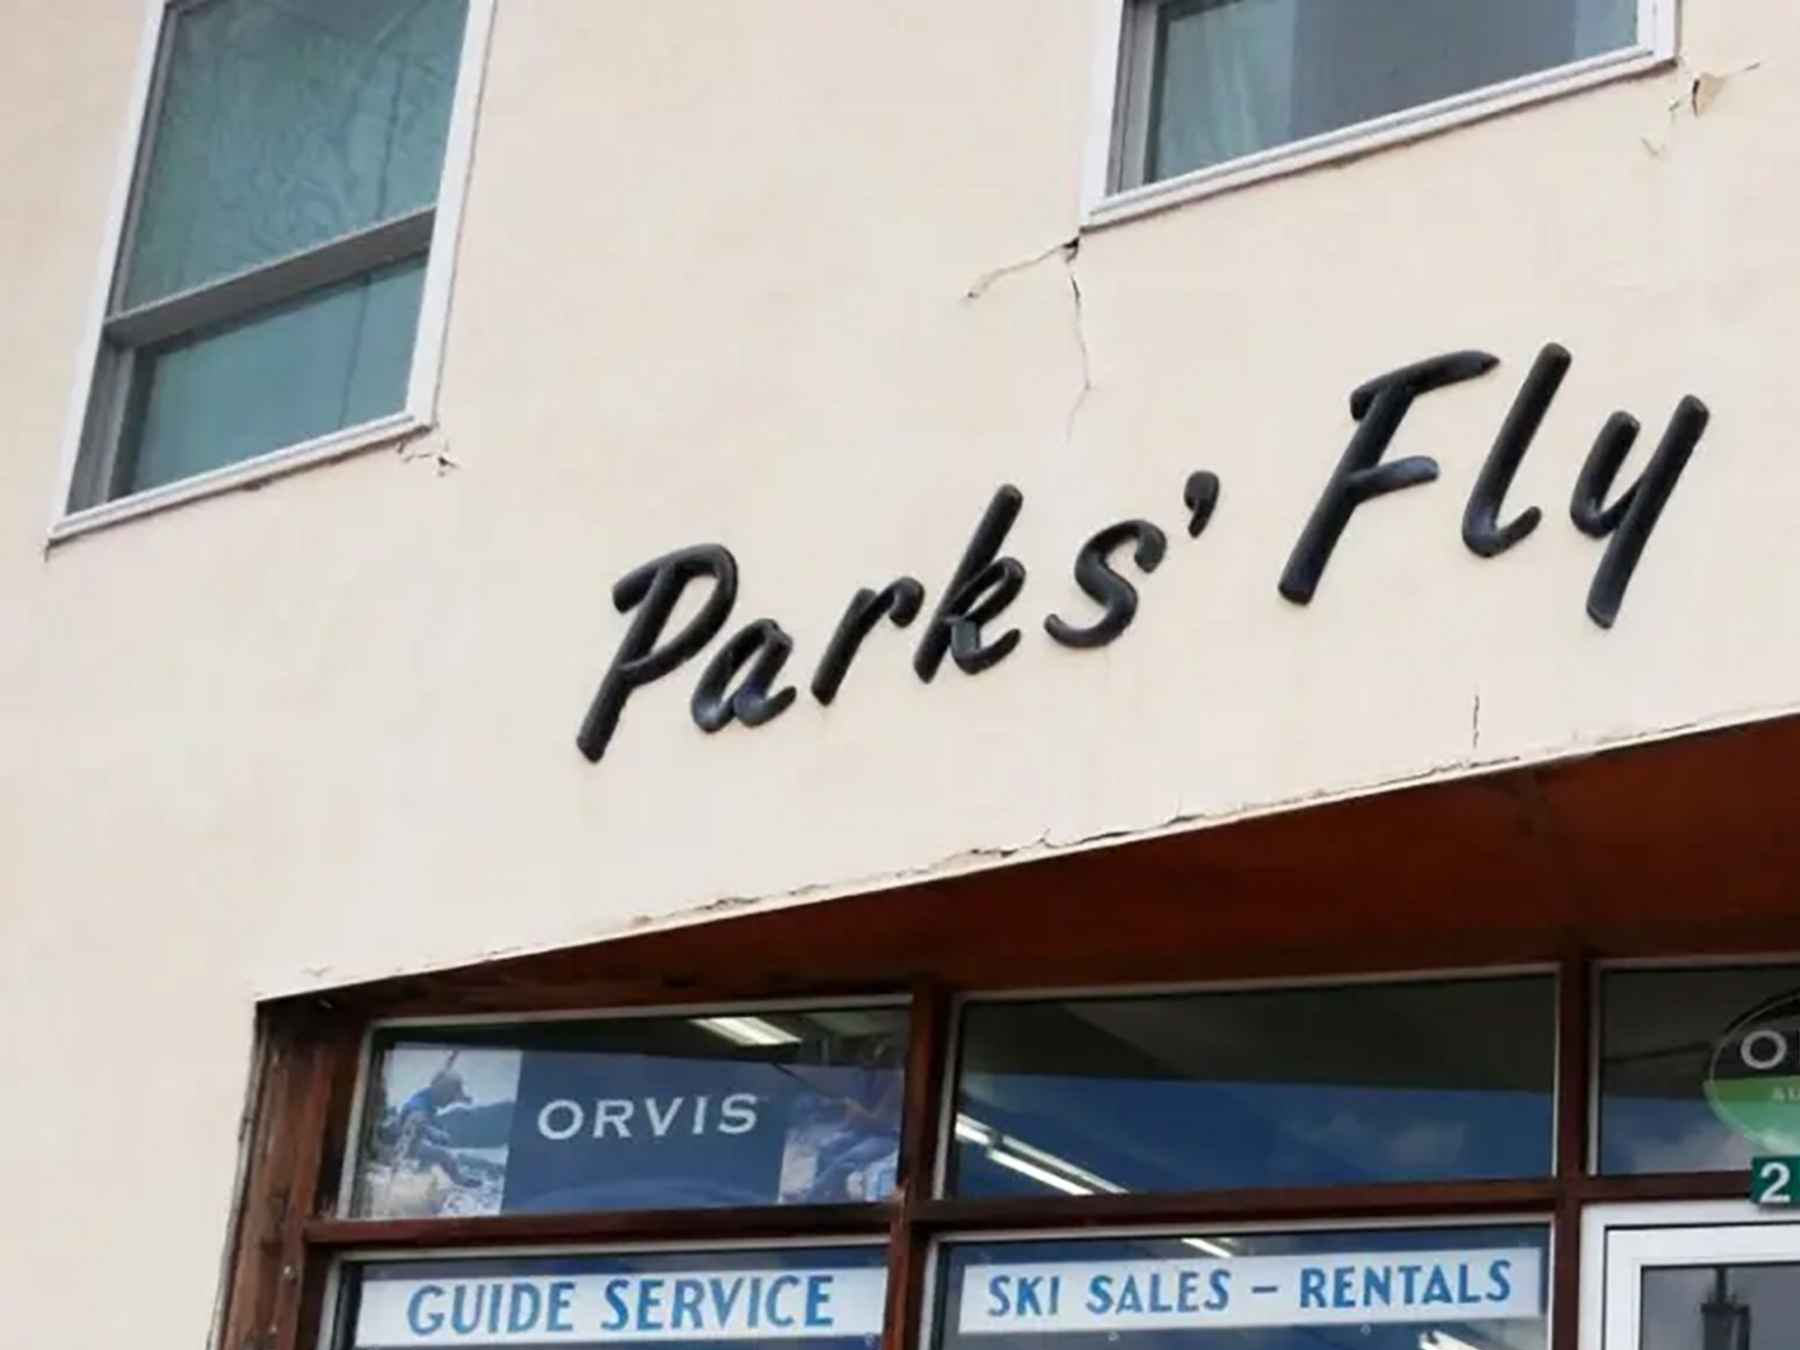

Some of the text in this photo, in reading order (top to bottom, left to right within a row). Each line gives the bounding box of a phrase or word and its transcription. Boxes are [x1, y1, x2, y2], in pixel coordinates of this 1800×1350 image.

[577, 470, 1219, 763] Parks'
[1279, 342, 1709, 629] Fly
[538, 1093, 758, 1141] ORVIS
[406, 1274, 834, 1337] GUIDE SERVICE
[987, 1274, 1062, 1318] SKI
[1085, 1268, 1232, 1313] SALES
[1298, 1259, 1512, 1309] RENTALS
